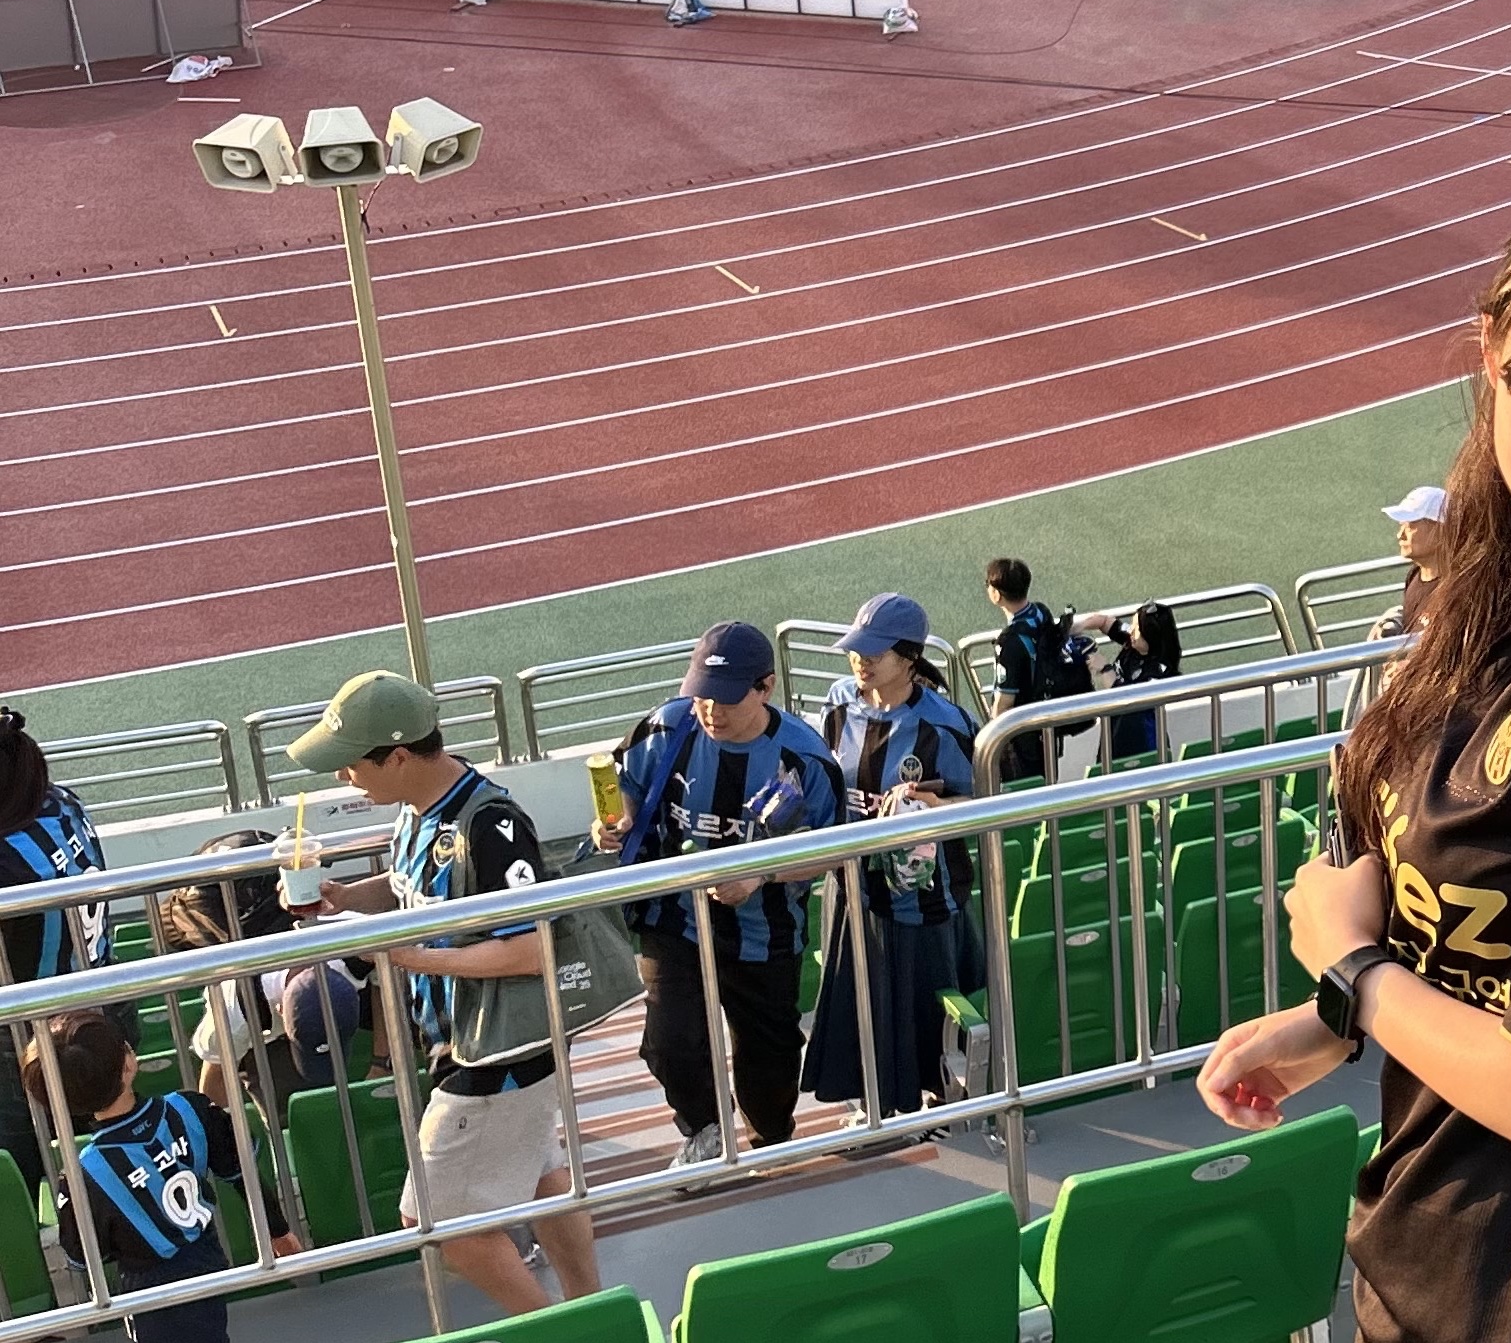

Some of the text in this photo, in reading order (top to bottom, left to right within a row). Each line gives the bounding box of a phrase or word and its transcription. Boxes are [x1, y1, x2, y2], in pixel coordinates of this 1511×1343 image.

[670, 801, 755, 843] 푸르지
[127, 1136, 189, 1189] 무고사
[855, 1253, 867, 1265] 17
